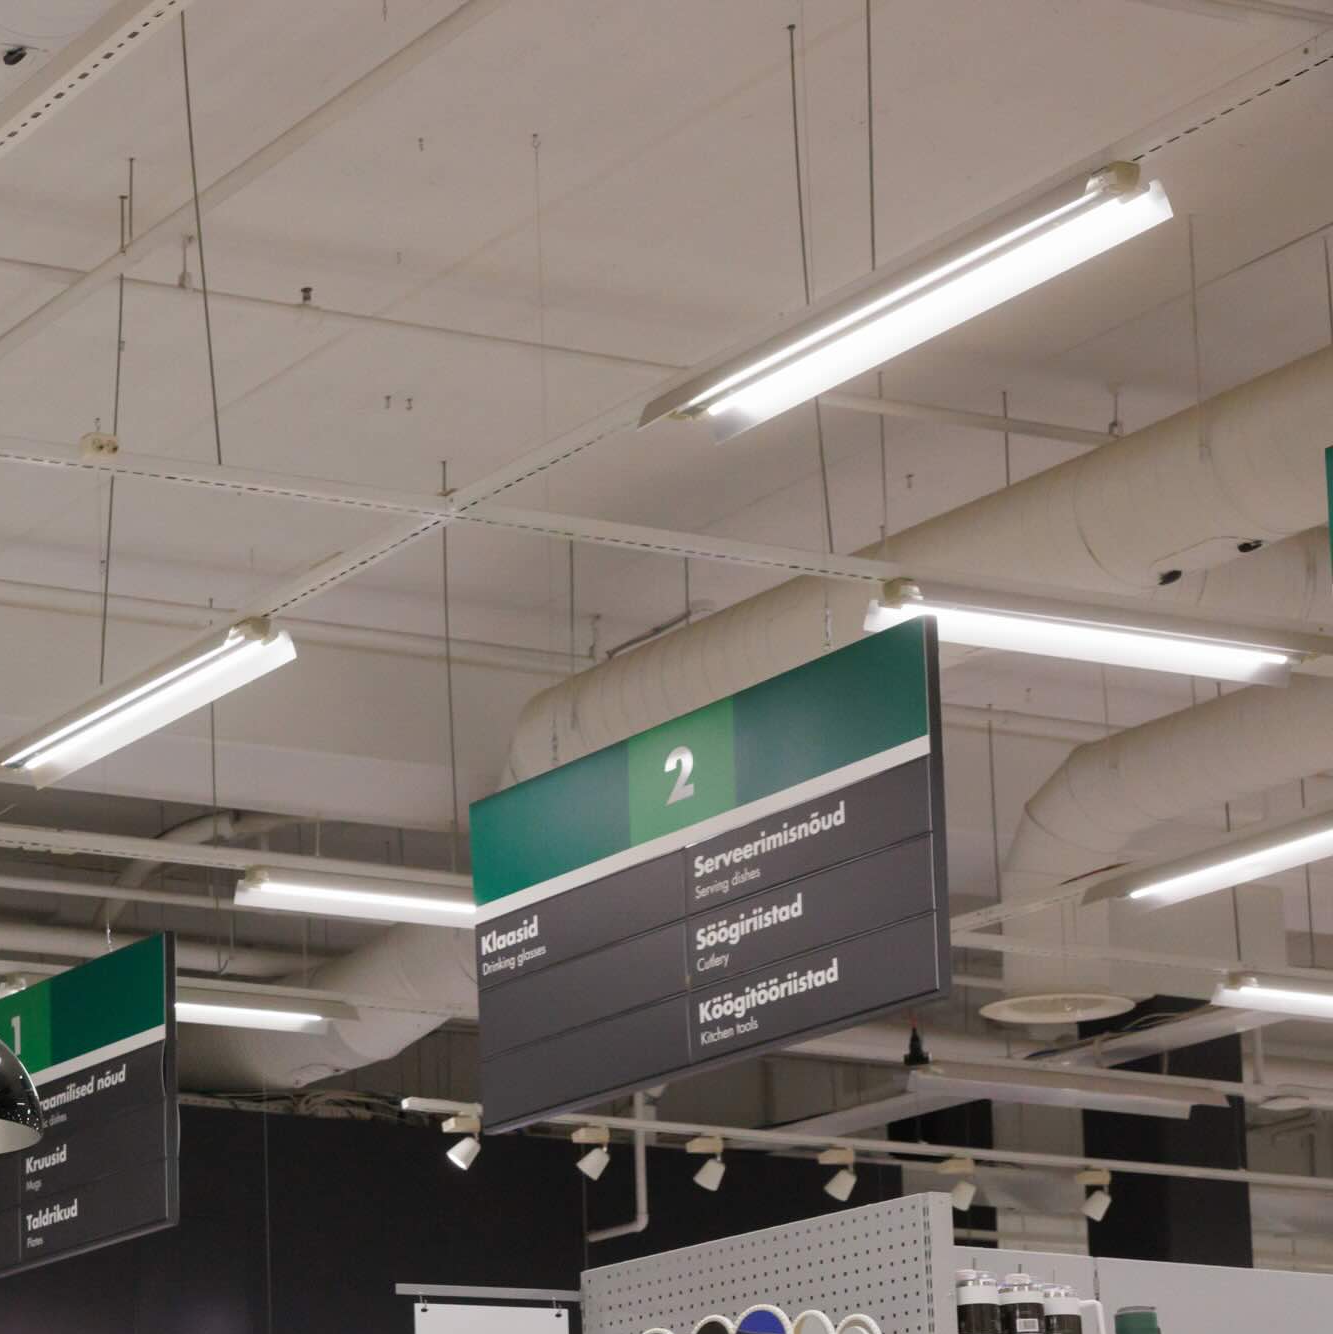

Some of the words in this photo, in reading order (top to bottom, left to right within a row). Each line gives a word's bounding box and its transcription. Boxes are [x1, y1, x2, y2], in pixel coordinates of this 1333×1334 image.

[664, 745, 695, 806] 2
[694, 801, 846, 878] Serveerimisnõud
[695, 878, 729, 900] Serving
[731, 866, 761, 890] dishes
[480, 915, 539, 955] Klaasid
[696, 894, 803, 951] Söögiriistad
[482, 954, 515, 976] Drinking
[517, 945, 546, 970] glasses
[697, 952, 730, 974] Cutlery
[698, 958, 839, 1024] Köögitööriistad
[11, 1015, 22, 1056] 1
[700, 1022, 734, 1046] Kitchen
[736, 1017, 759, 1039] tools
[39, 1074, 94, 1112] raamilised
[97, 1064, 126, 1091] nõud
[25, 1144, 68, 1174] Kruusid
[26, 1199, 78, 1232] Taldrikud
